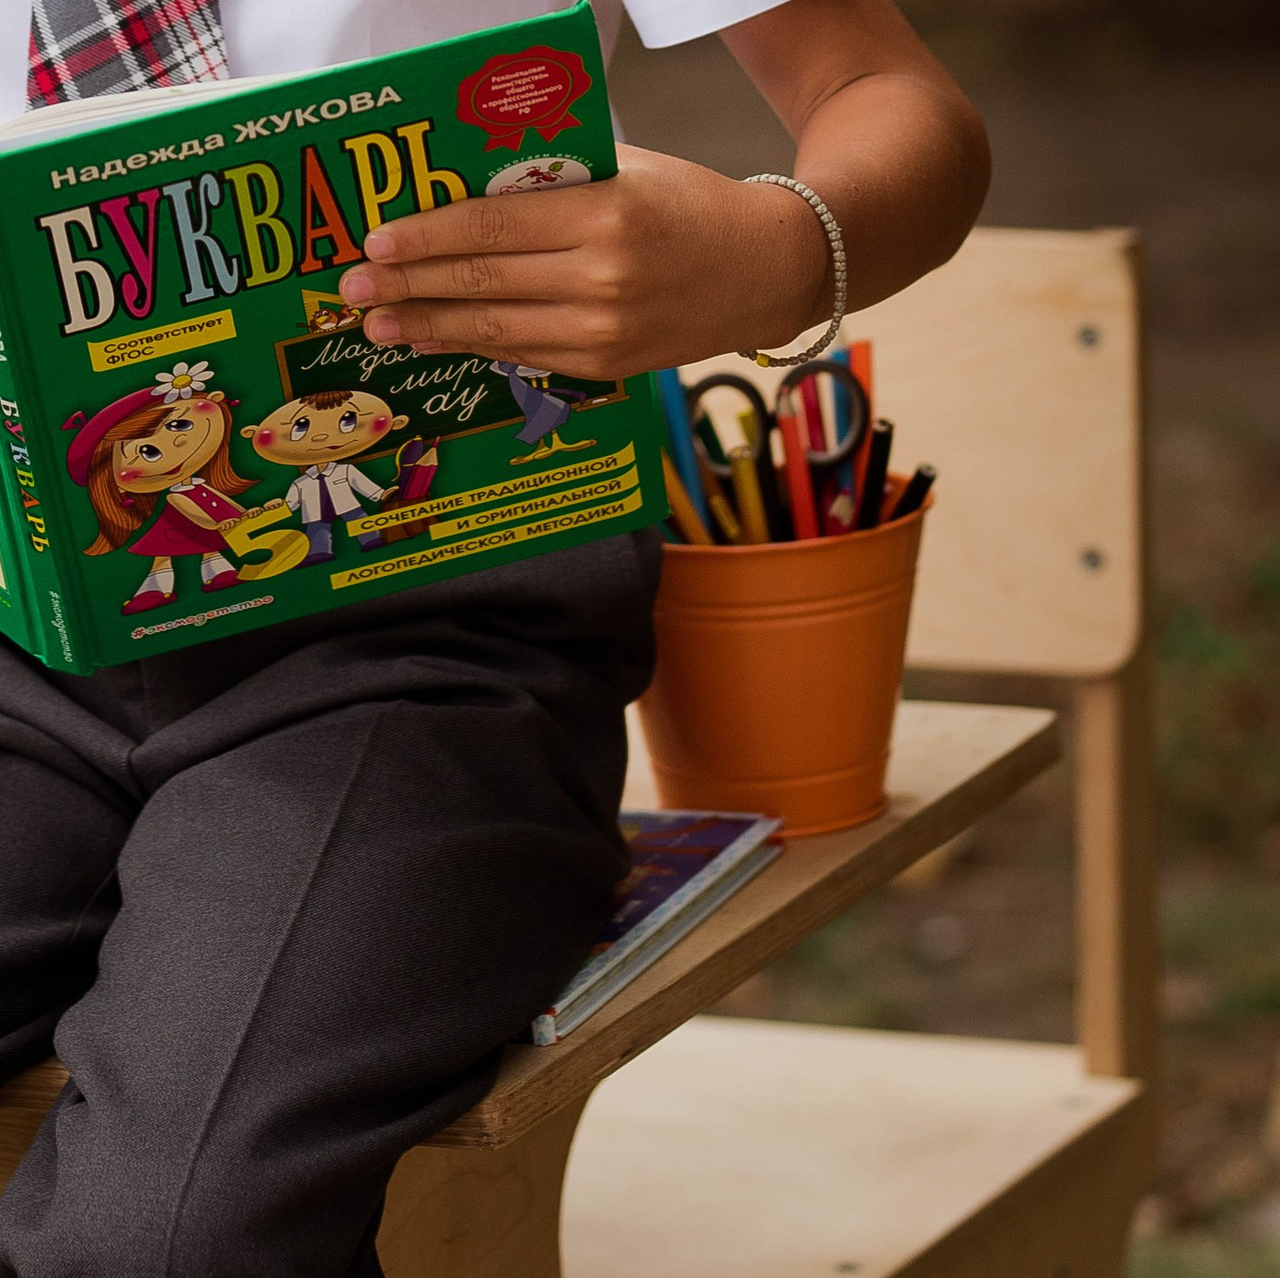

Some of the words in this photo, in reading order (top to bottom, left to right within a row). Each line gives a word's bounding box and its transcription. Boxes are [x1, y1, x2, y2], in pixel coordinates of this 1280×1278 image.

[506, 83, 535, 95] общего
[50, 133, 225, 190] Надежда
[232, 85, 403, 144] ЖУКОВА
[37, 117, 471, 339] БУКВАРЬ
[103, 317, 224, 354] Соответствует
[106, 346, 155, 365] ФГОС
[390, 358, 489, 393] мир
[422, 383, 489, 422] ау
[0, 396, 50, 553] БУКВАРЬ
[360, 496, 465, 531] СОЧЕТАНИЕ
[468, 456, 618, 506] ТРАДИЦИОННОЙ
[456, 519, 470, 531] И
[475, 479, 622, 526] ОРИГИНАЛЬНОЙ
[219, 499, 311, 581] 5
[346, 530, 517, 583] ЛОГОПЕДИЧЕСКОЙ
[526, 502, 625, 536] МЕТОДИКИ
[131, 595, 274, 640] #эксмодетство
